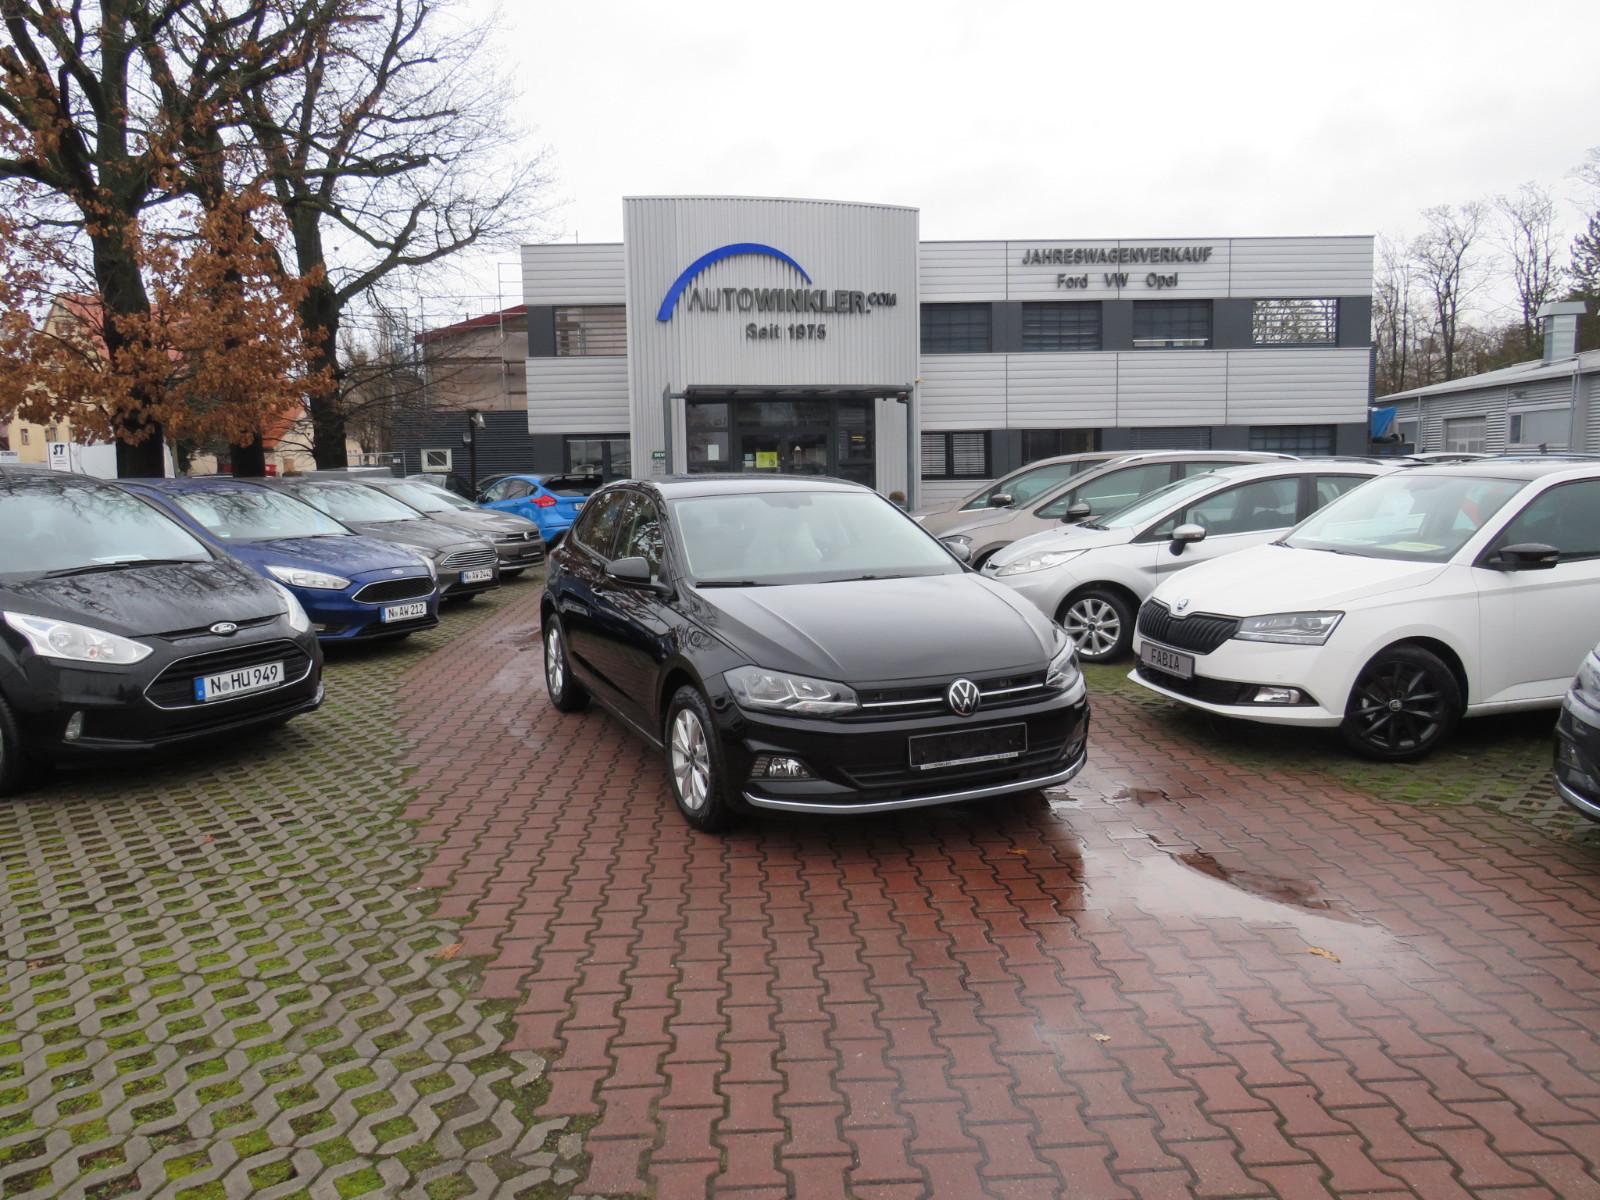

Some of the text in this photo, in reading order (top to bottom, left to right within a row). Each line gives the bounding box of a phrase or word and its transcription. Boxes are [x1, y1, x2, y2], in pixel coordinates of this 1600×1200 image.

[1022, 247, 1213, 265] JAHRESWAGENVERKAUF
[1057, 272, 1178, 290] Ford VW Opel
[746, 323, 826, 340] Seit 1975
[388, 603, 424, 618] N AW 212
[1151, 648, 1180, 672] FABIA
[211, 665, 278, 695] N HU 949
